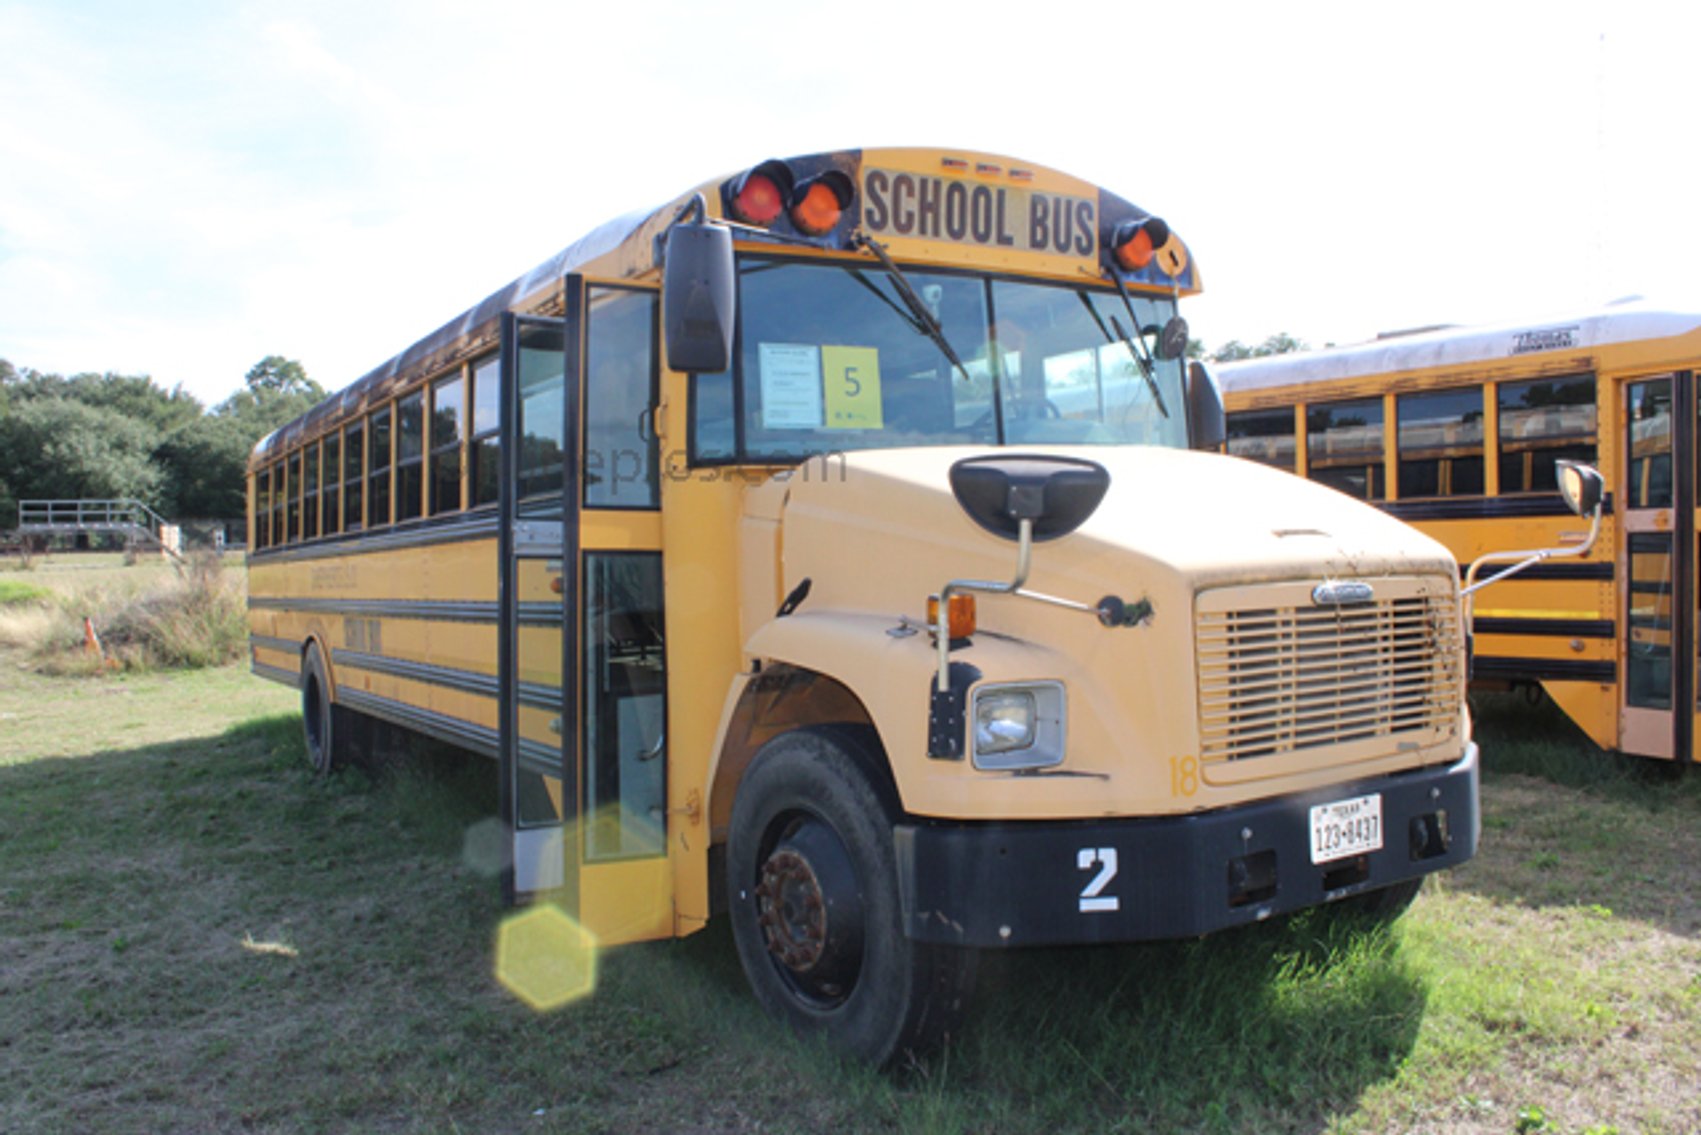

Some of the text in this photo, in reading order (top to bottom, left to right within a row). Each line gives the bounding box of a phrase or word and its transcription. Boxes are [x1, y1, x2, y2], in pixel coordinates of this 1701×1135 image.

[864, 169, 1095, 256] SCHOOL BUS
[844, 366, 862, 398] 5
[1169, 754, 1199, 797] 18
[1076, 847, 1119, 913] 2
